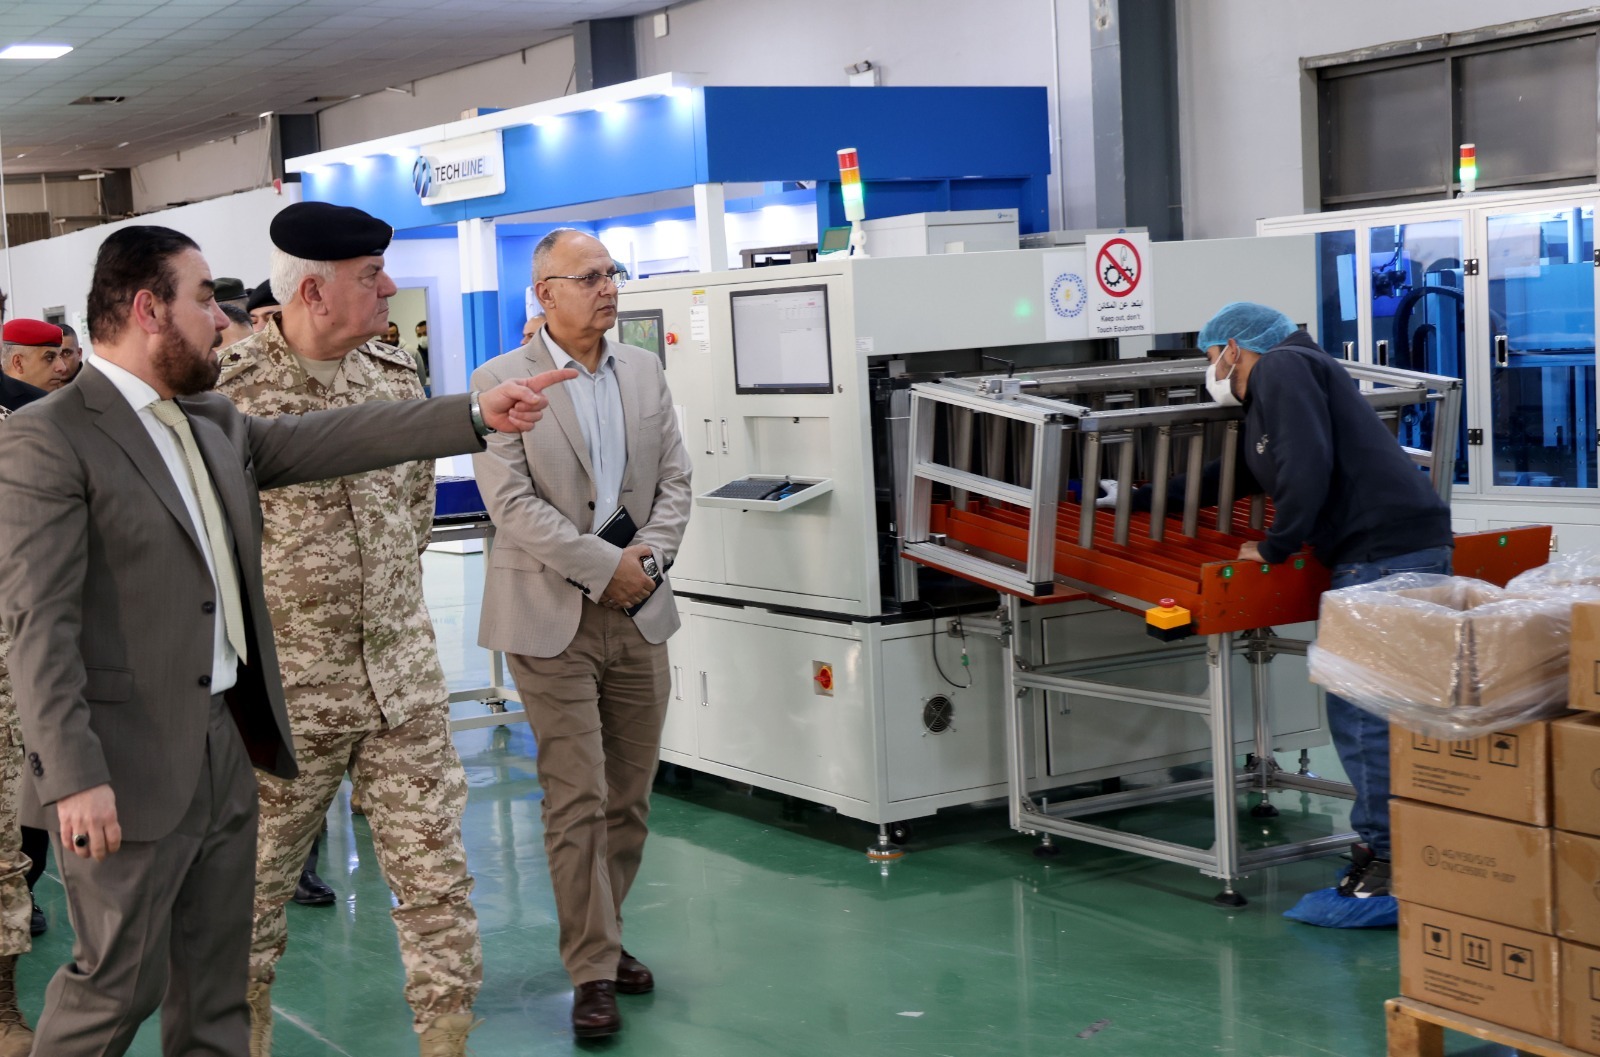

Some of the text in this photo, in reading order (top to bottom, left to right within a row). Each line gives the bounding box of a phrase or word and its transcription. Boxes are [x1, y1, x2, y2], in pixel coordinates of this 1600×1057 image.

[435, 158, 483, 182] TECH LINE
[1119, 301, 1128, 310] عن
